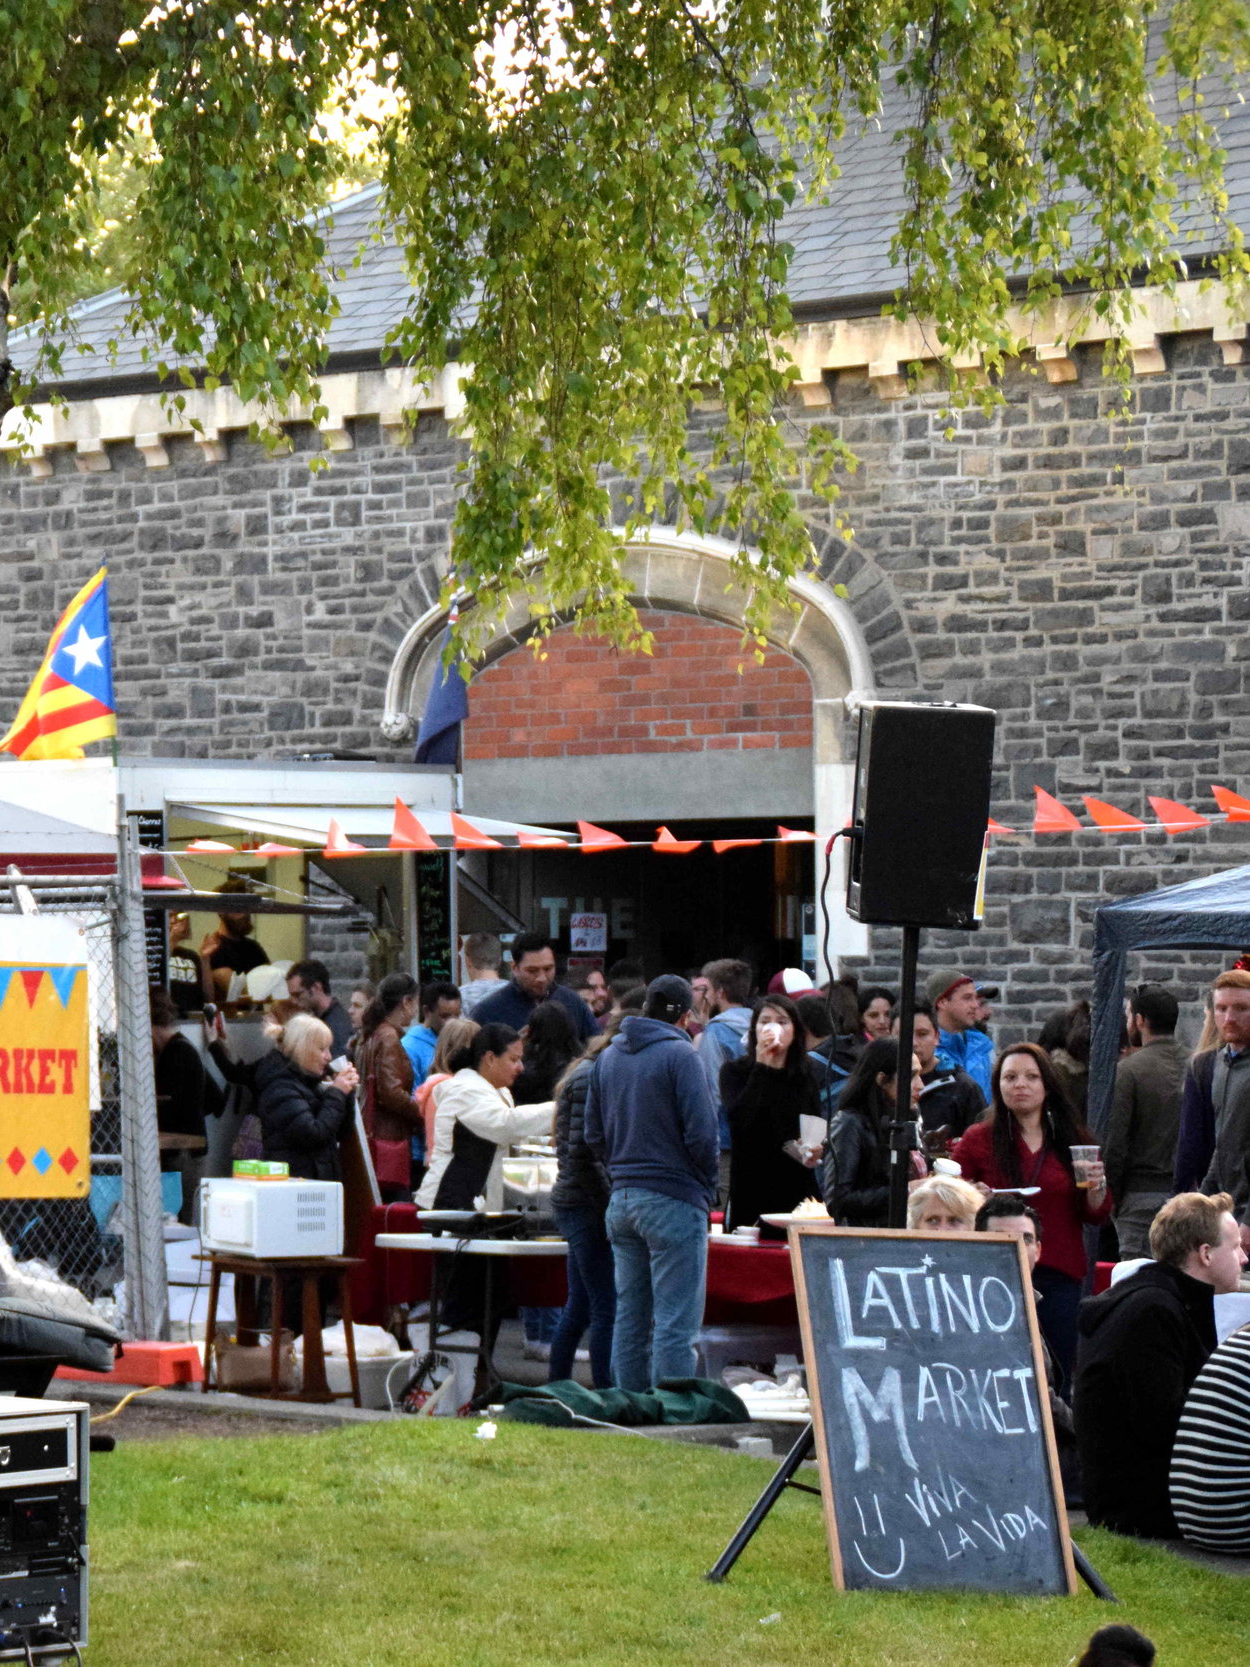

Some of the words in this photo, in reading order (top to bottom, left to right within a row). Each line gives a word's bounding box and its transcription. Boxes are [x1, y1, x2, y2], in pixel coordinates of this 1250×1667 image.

[841, 1362, 1038, 1472] MARKET
[938, 1522, 979, 1560] LA
[972, 1504, 1048, 1552] VIDA
